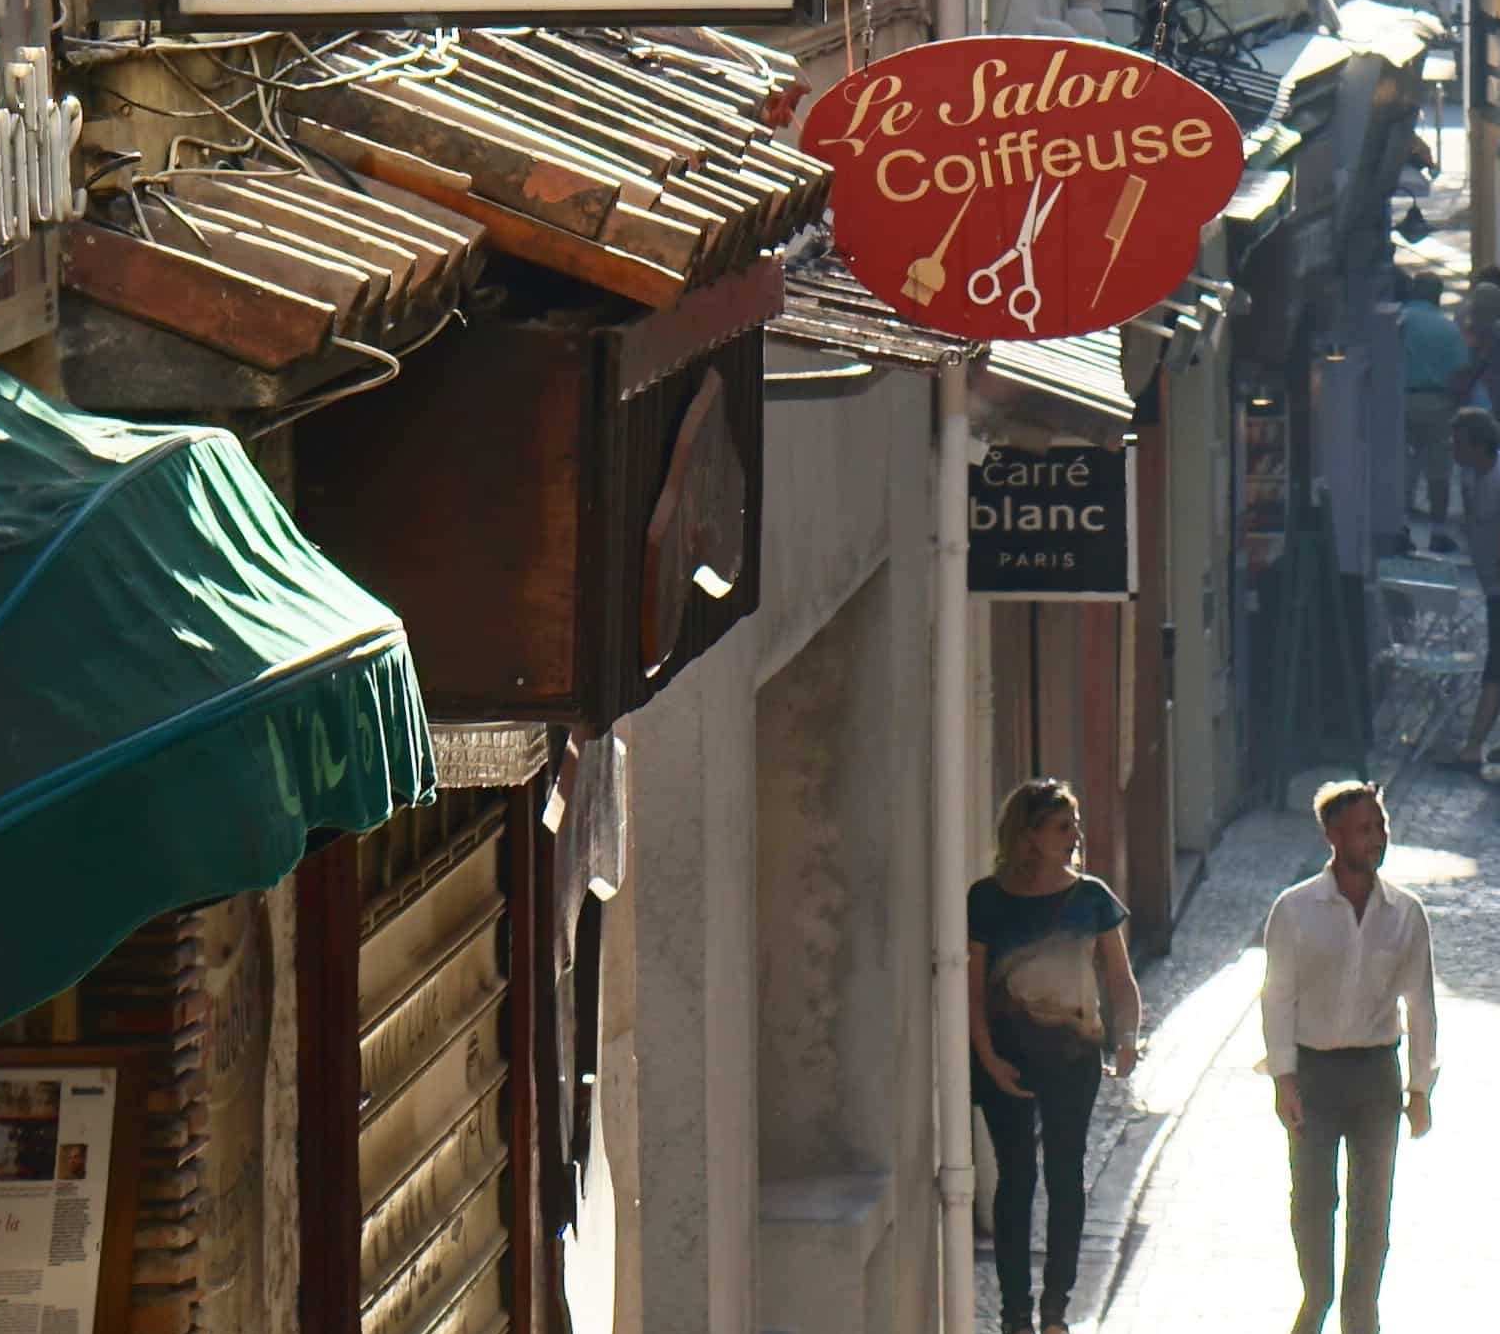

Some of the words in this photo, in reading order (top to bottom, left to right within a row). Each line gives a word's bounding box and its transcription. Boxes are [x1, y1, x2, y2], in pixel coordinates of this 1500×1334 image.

[819, 73, 924, 157] Le
[938, 48, 1157, 128] Salon
[875, 117, 1214, 204] Coiffeuse
[970, 495, 1106, 532] blanc
[999, 552, 1077, 569] PARIS
[5, 1212, 21, 1232] la
